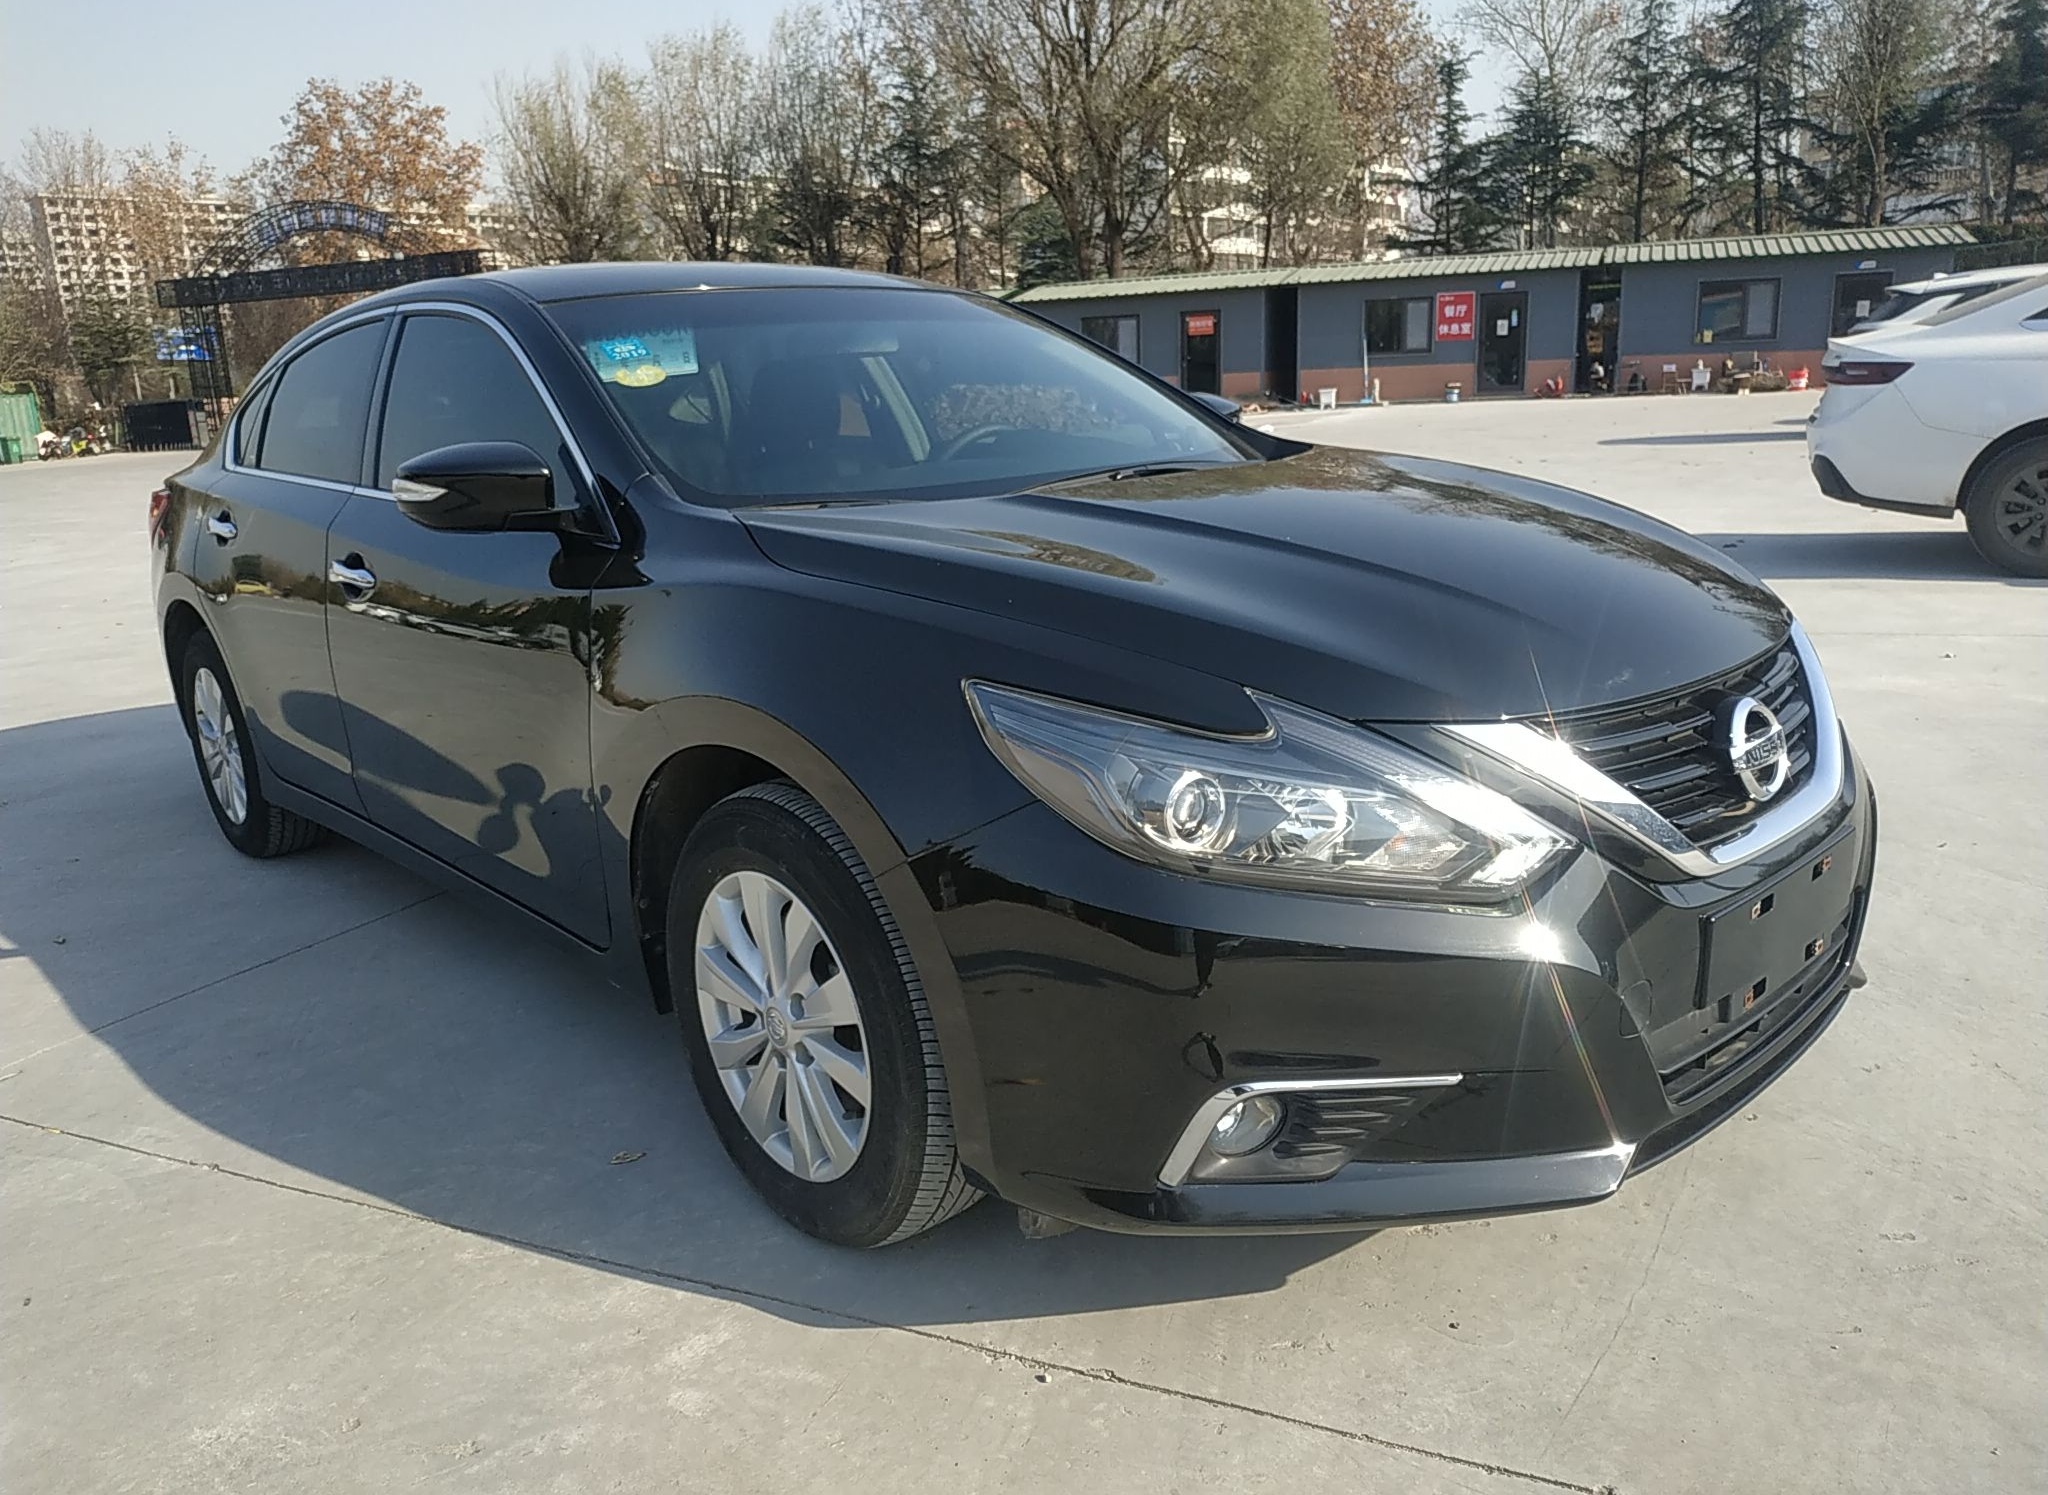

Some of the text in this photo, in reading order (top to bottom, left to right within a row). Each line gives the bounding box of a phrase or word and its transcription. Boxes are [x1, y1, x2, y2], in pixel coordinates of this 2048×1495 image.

[1444, 304, 1468, 318] 餐厅
[611, 348, 647, 361] 2019
[1746, 731, 1784, 765] NISS
